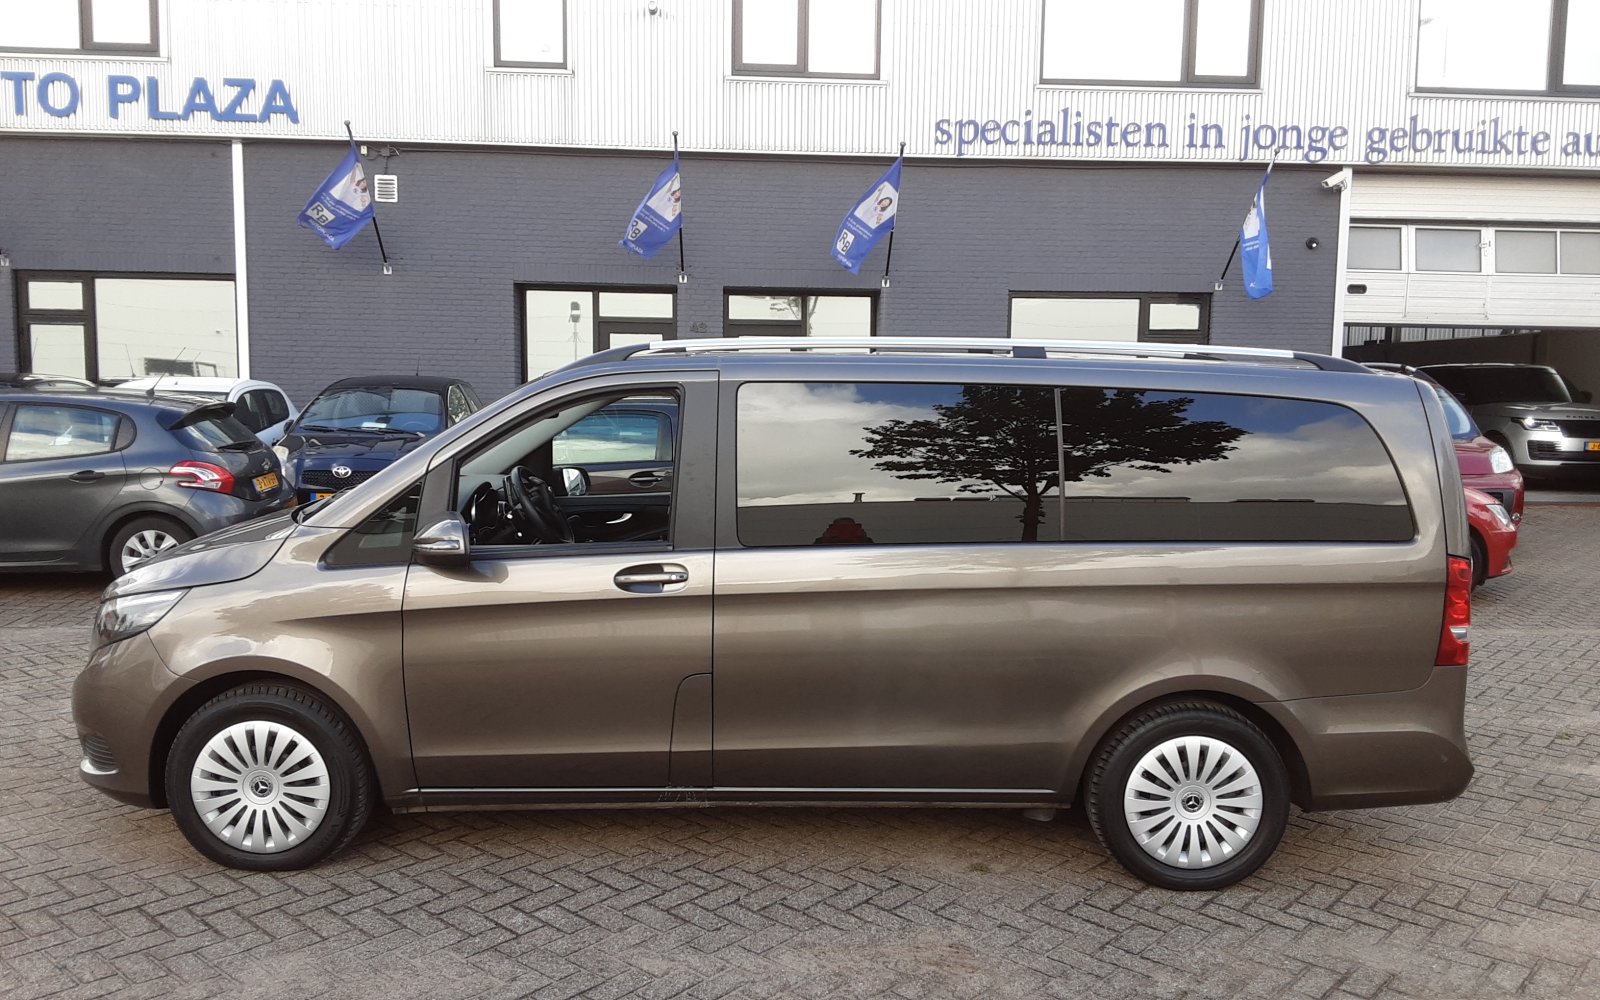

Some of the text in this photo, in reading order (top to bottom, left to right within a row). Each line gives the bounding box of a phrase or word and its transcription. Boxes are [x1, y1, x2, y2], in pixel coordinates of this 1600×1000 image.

[0, 71, 300, 124] TO PLAZA
[934, 106, 1169, 156] specialisten
[1186, 112, 1226, 149] in
[1239, 114, 1349, 163] jonge
[1364, 114, 1551, 165] gebruikte
